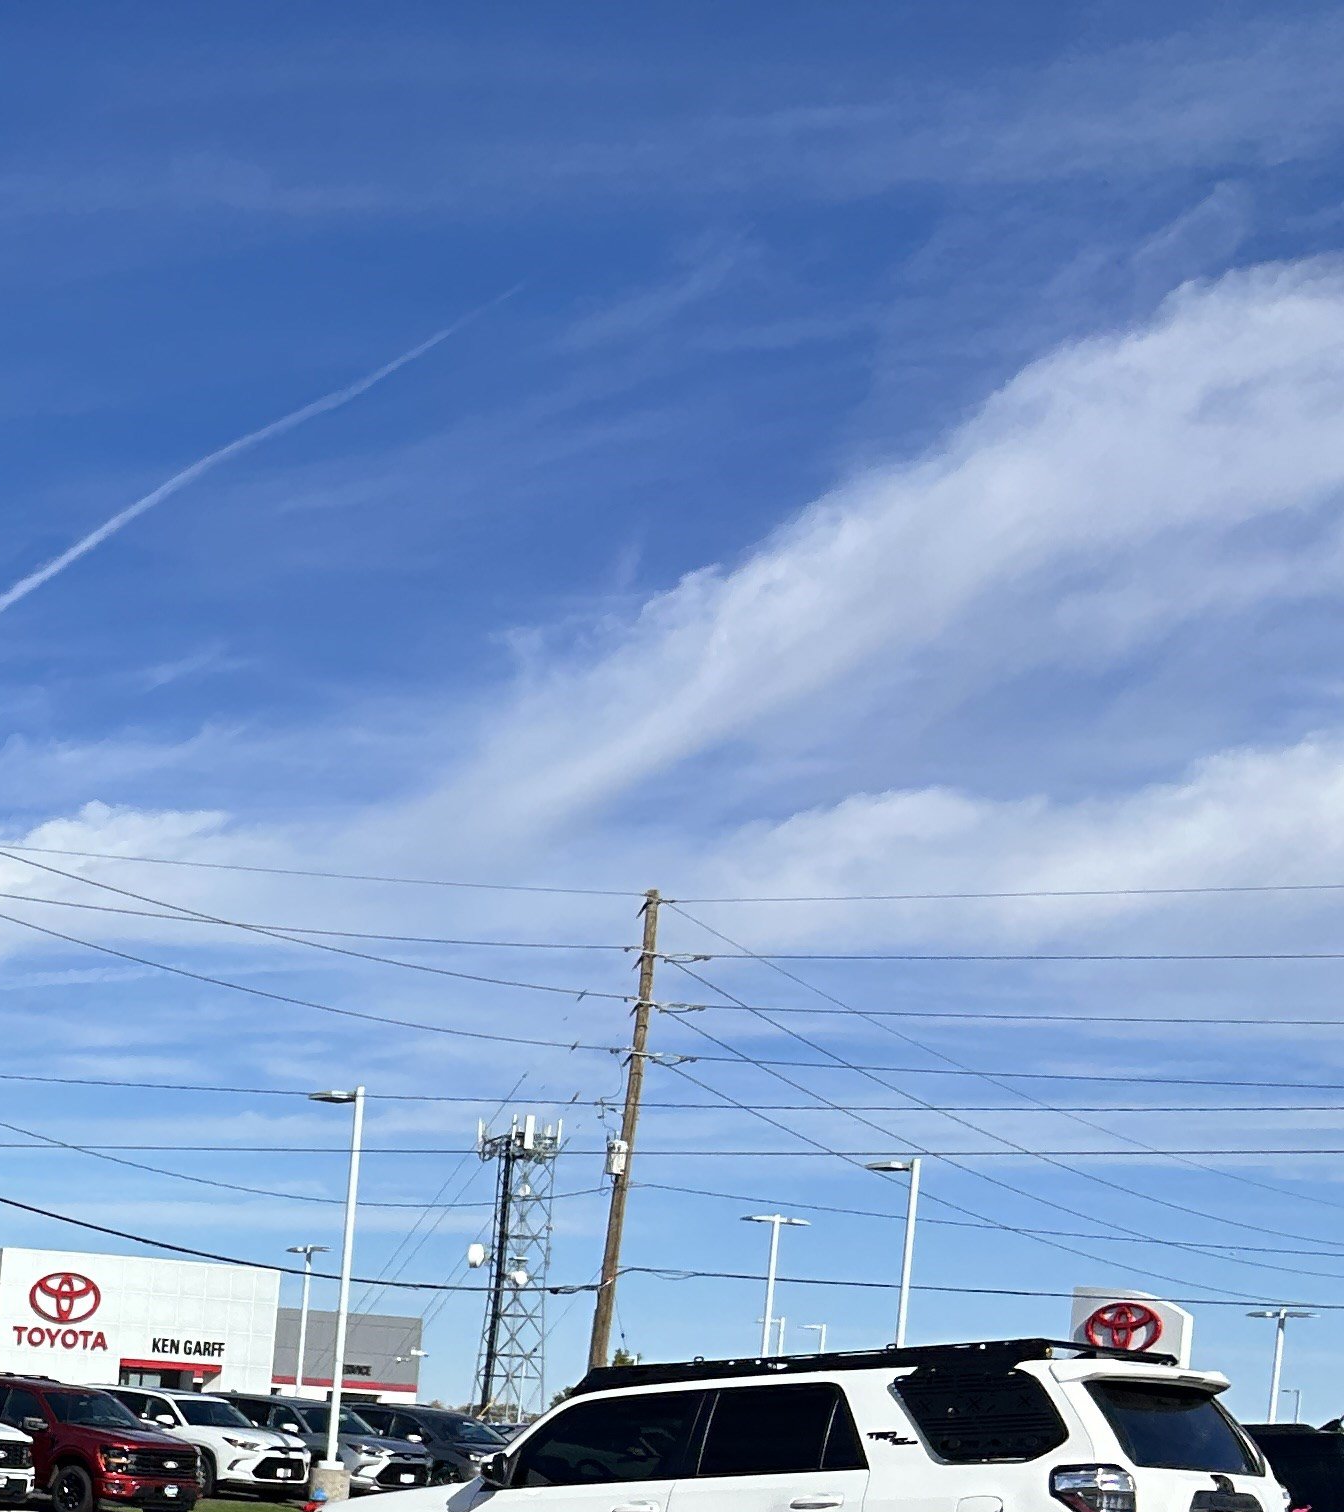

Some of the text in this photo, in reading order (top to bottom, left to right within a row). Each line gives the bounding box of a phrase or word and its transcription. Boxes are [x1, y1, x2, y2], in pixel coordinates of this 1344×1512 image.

[13, 1326, 108, 1351] TOYOTA
[152, 1337, 225, 1357] KEN GARFF
